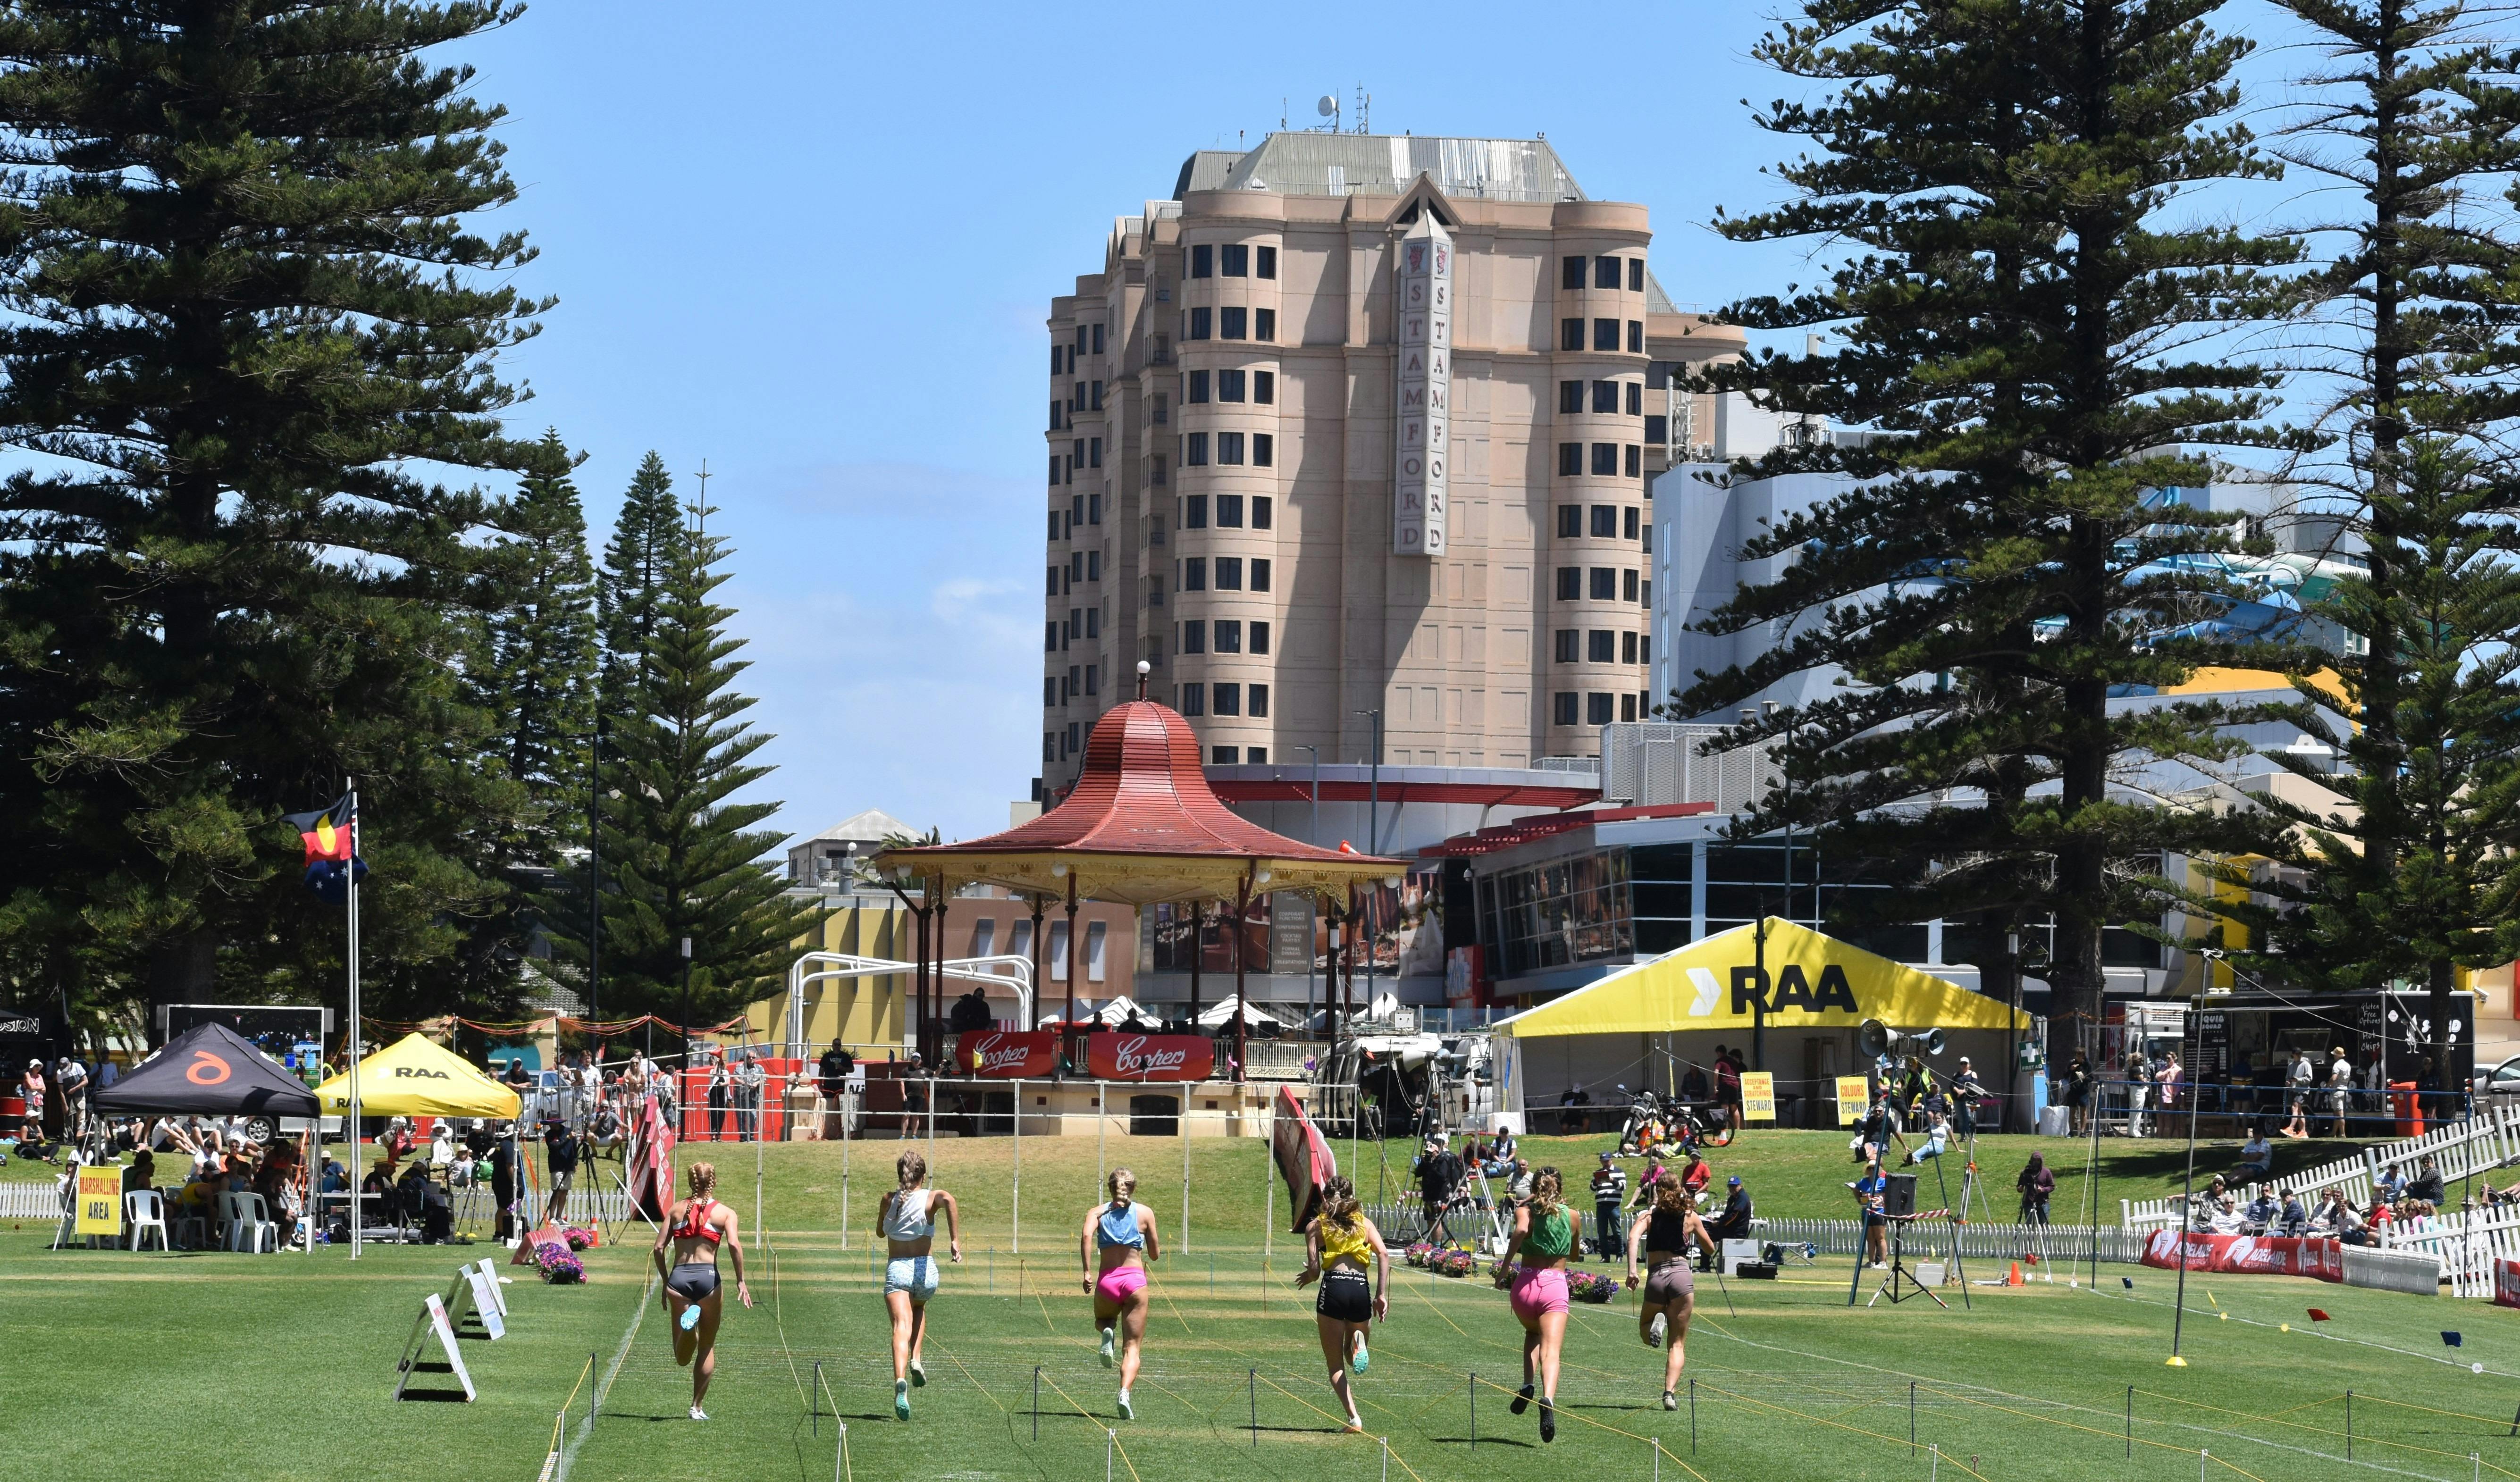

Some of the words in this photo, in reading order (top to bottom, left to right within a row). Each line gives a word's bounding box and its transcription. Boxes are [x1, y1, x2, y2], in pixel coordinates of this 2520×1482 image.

[1403, 285, 1424, 544] STAMFORD
[1429, 286, 1445, 548] STAMFORD
[1730, 965, 1858, 1014] RAA
[975, 1033, 1030, 1071] Coopers
[1116, 1036, 1186, 1074] Coopers
[395, 1067, 451, 1080] RAA
[1840, 1084, 1864, 1097] COLOURS
[1747, 1100, 1772, 1111] STEWARD
[1841, 1101, 1866, 1114] STEWARD
[79, 1177, 119, 1196] MARSHALLING
[88, 1202, 109, 1220] AREA
[2248, 1248, 2286, 1266] ADELAIDE
